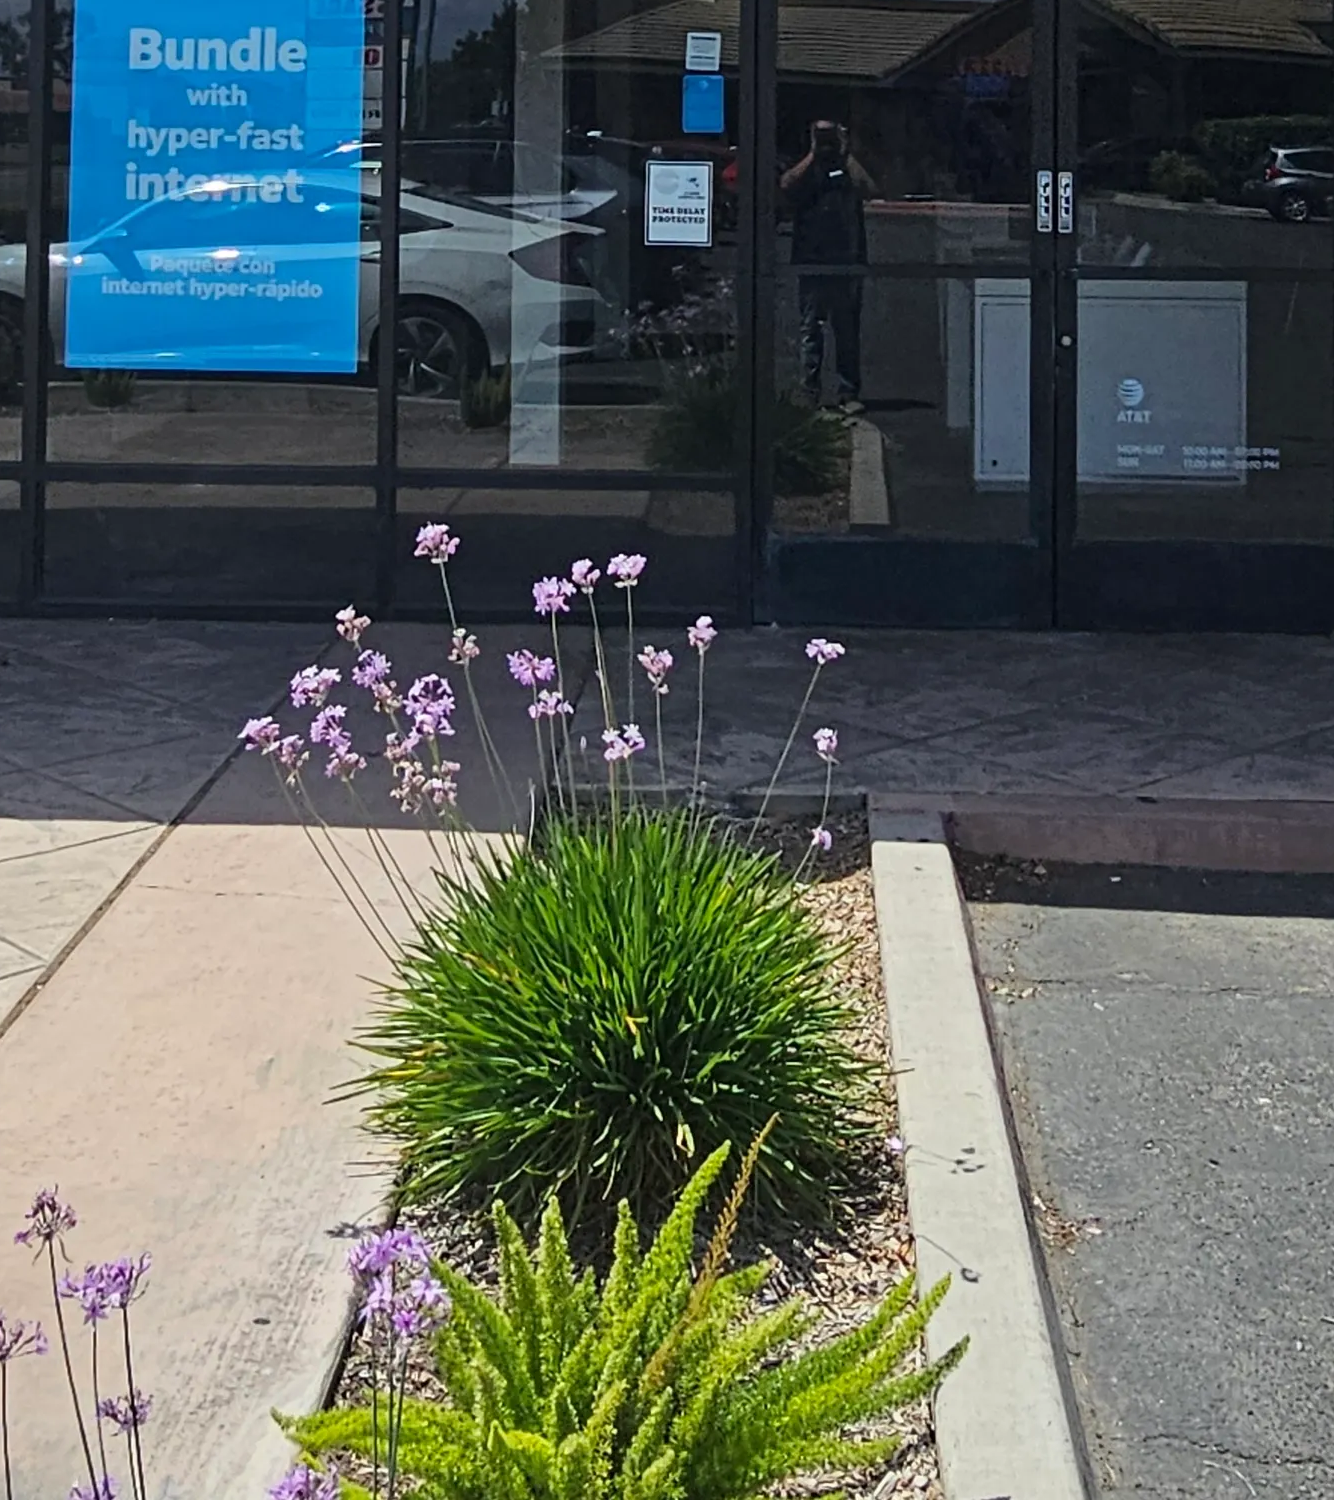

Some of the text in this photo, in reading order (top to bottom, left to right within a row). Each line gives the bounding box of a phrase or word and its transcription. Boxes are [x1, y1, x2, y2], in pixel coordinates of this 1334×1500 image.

[128, 27, 307, 72] Bundle
[186, 83, 247, 106] with
[127, 119, 305, 157] hyper-fast
[125, 162, 305, 204] internet
[651, 215, 706, 225] PROTECTED
[652, 206, 706, 216] TIME DELAY
[150, 256, 276, 277] Paquete con
[101, 277, 323, 302] internet hyper-rápido
[1117, 410, 1152, 424] AT&T
